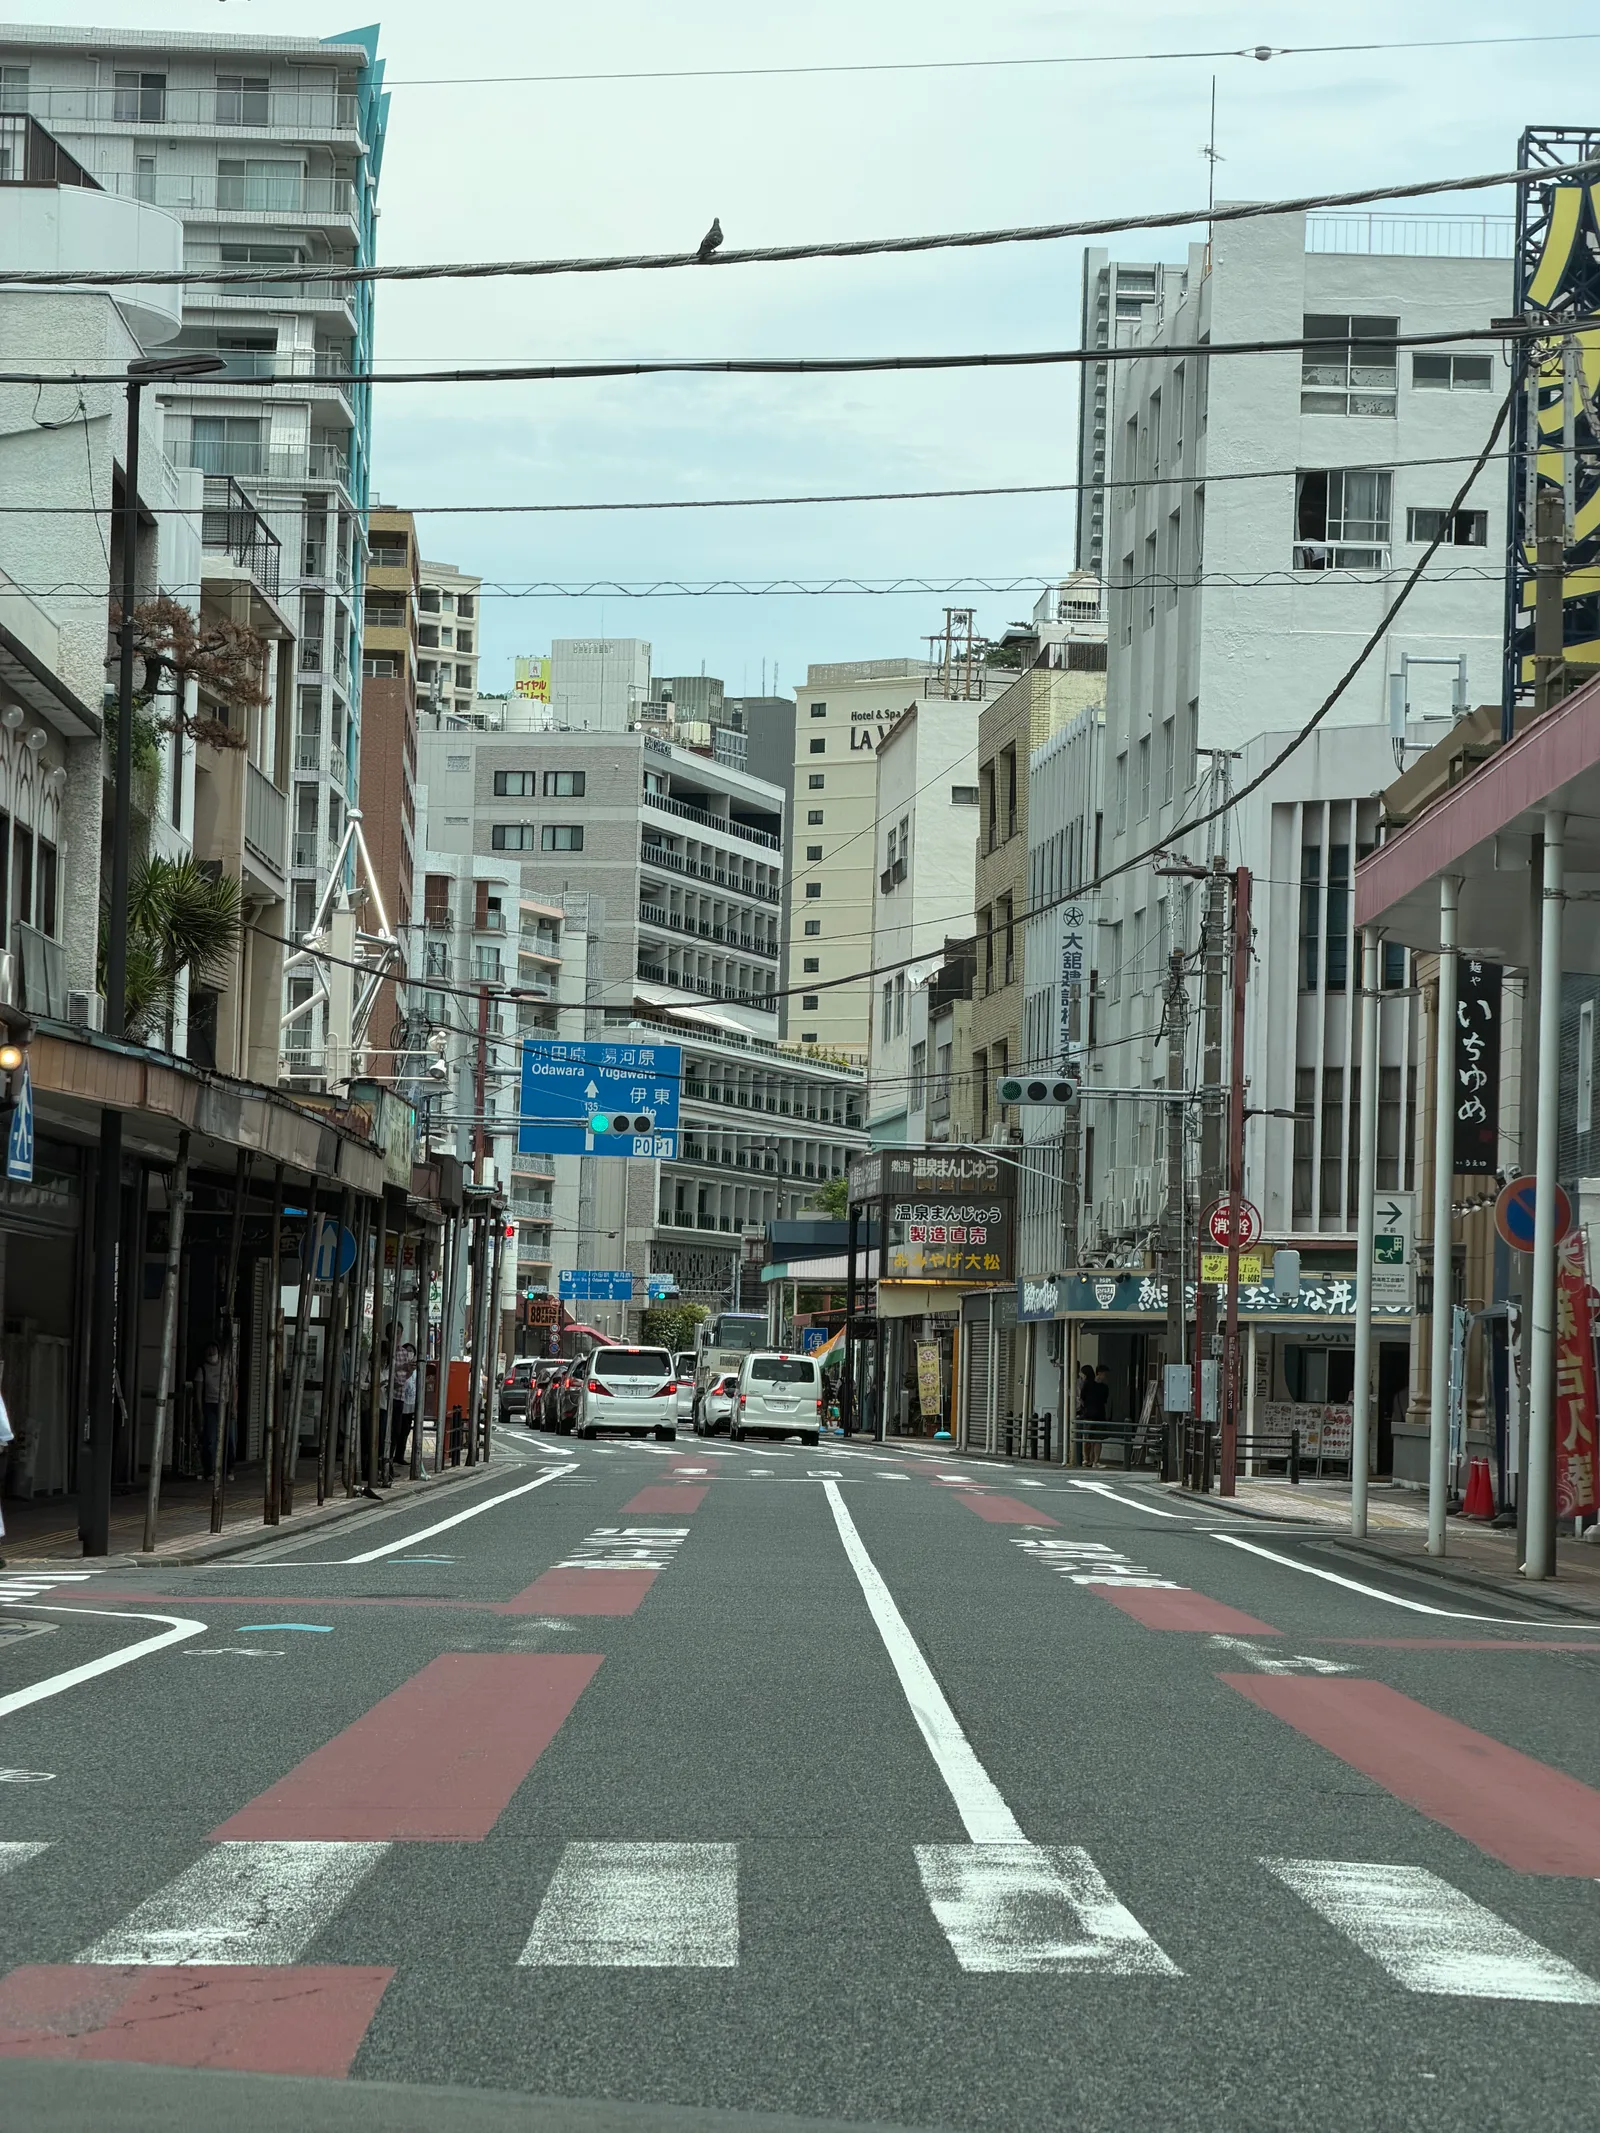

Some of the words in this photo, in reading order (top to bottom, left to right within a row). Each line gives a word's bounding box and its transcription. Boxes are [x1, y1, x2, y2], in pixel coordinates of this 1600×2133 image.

[515, 680, 547, 691] ロイヤル
[851, 710, 874, 721] Hotel
[875, 709, 884, 720] &
[884, 708, 901, 721] Spa
[850, 726, 873, 751] LA
[1469, 960, 1483, 987] 麺や
[532, 1046, 586, 1062] 小田原
[601, 1047, 655, 1066] 湯河原
[1457, 999, 1492, 1124] いちゆめ
[531, 1063, 585, 1077] Odawara
[598, 1066, 657, 1081] Yugawara
[630, 1086, 671, 1105] 伊東
[584, 1101, 599, 1112] 135
[642, 1106, 657, 1117] Ito
[656, 1142, 670, 1154] P1
[912, 1157, 998, 1179] 温泉まんじゅう
[895, 1204, 1002, 1223] 温泉まんじゅう
[909, 1225, 987, 1245] 製造直売
[1213, 1217, 1250, 1236] 消栓
[893, 1252, 1001, 1271] おみやげ大松
[530, 1306, 541, 1323] 88
